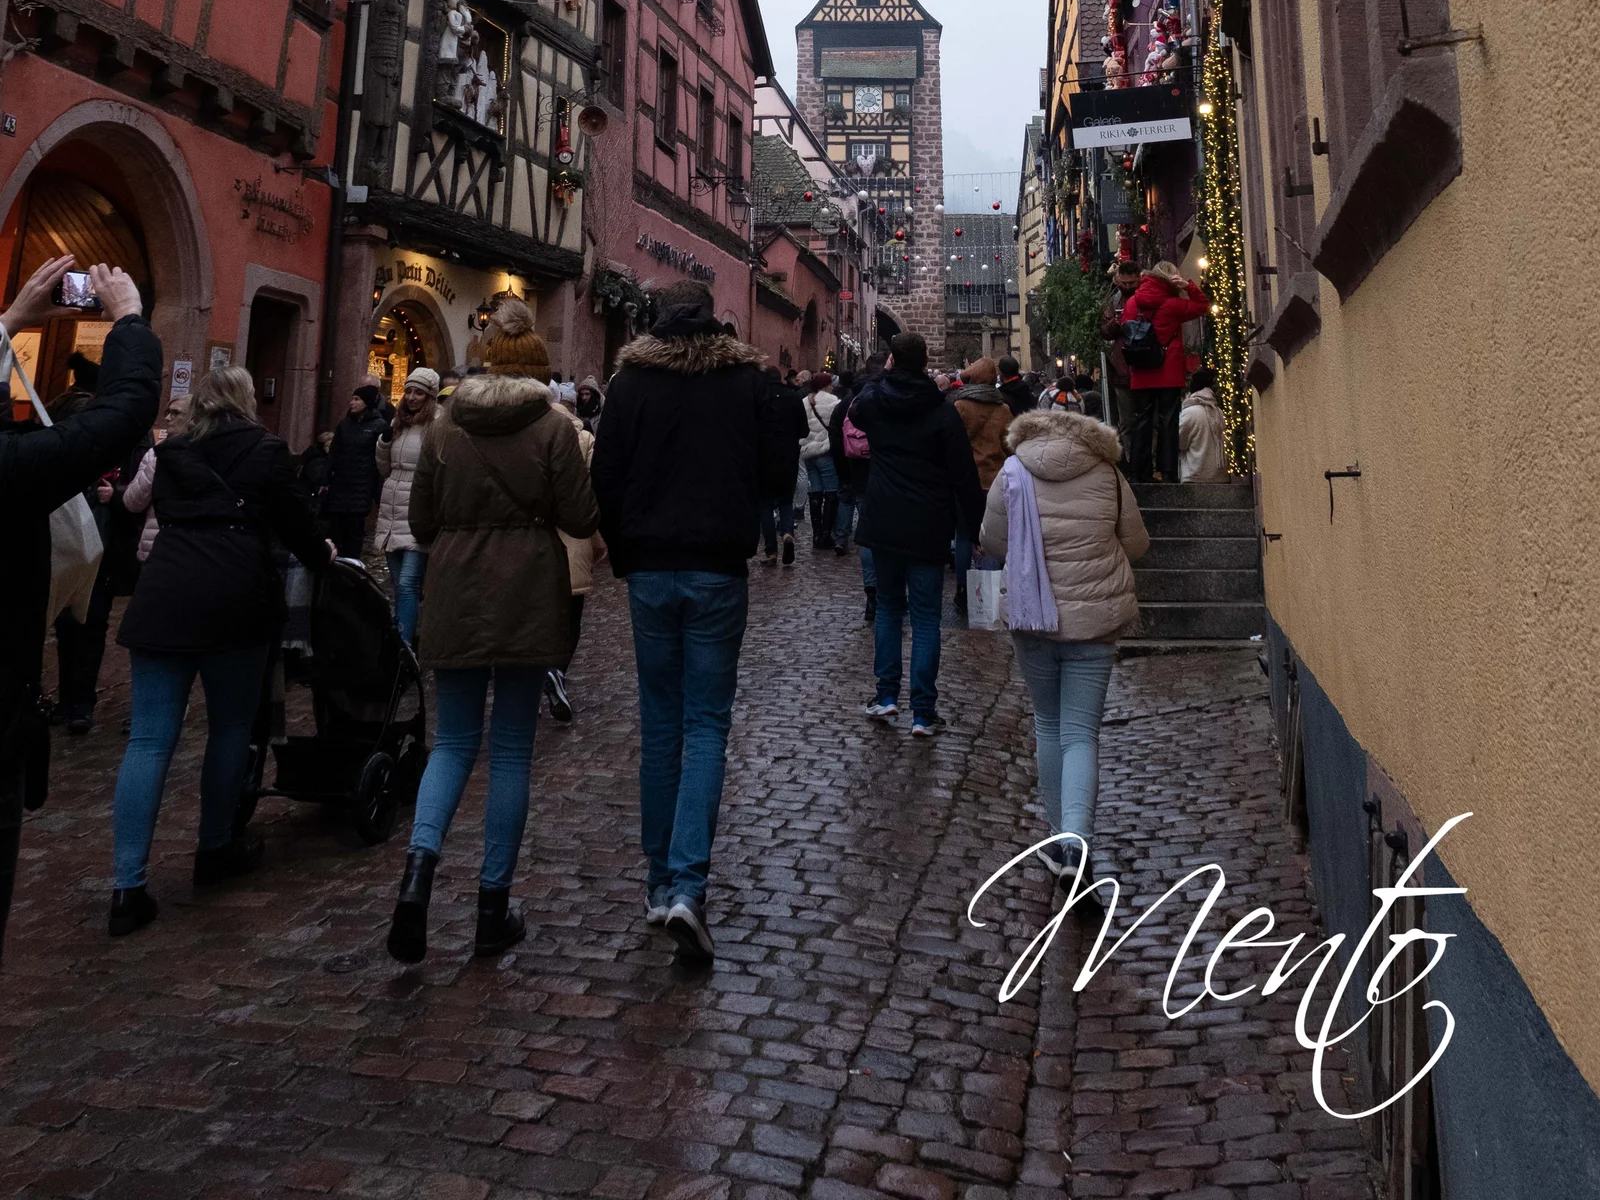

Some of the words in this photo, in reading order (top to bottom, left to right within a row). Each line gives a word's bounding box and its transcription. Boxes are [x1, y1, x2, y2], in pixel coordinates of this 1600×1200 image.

[4, 116, 17, 133] 43
[1083, 115, 1122, 128] Galerie
[1100, 128, 1127, 140] RIKIA
[1139, 124, 1177, 137] FERRER
[396, 260, 423, 285] Petit
[425, 266, 456, 304] Délice
